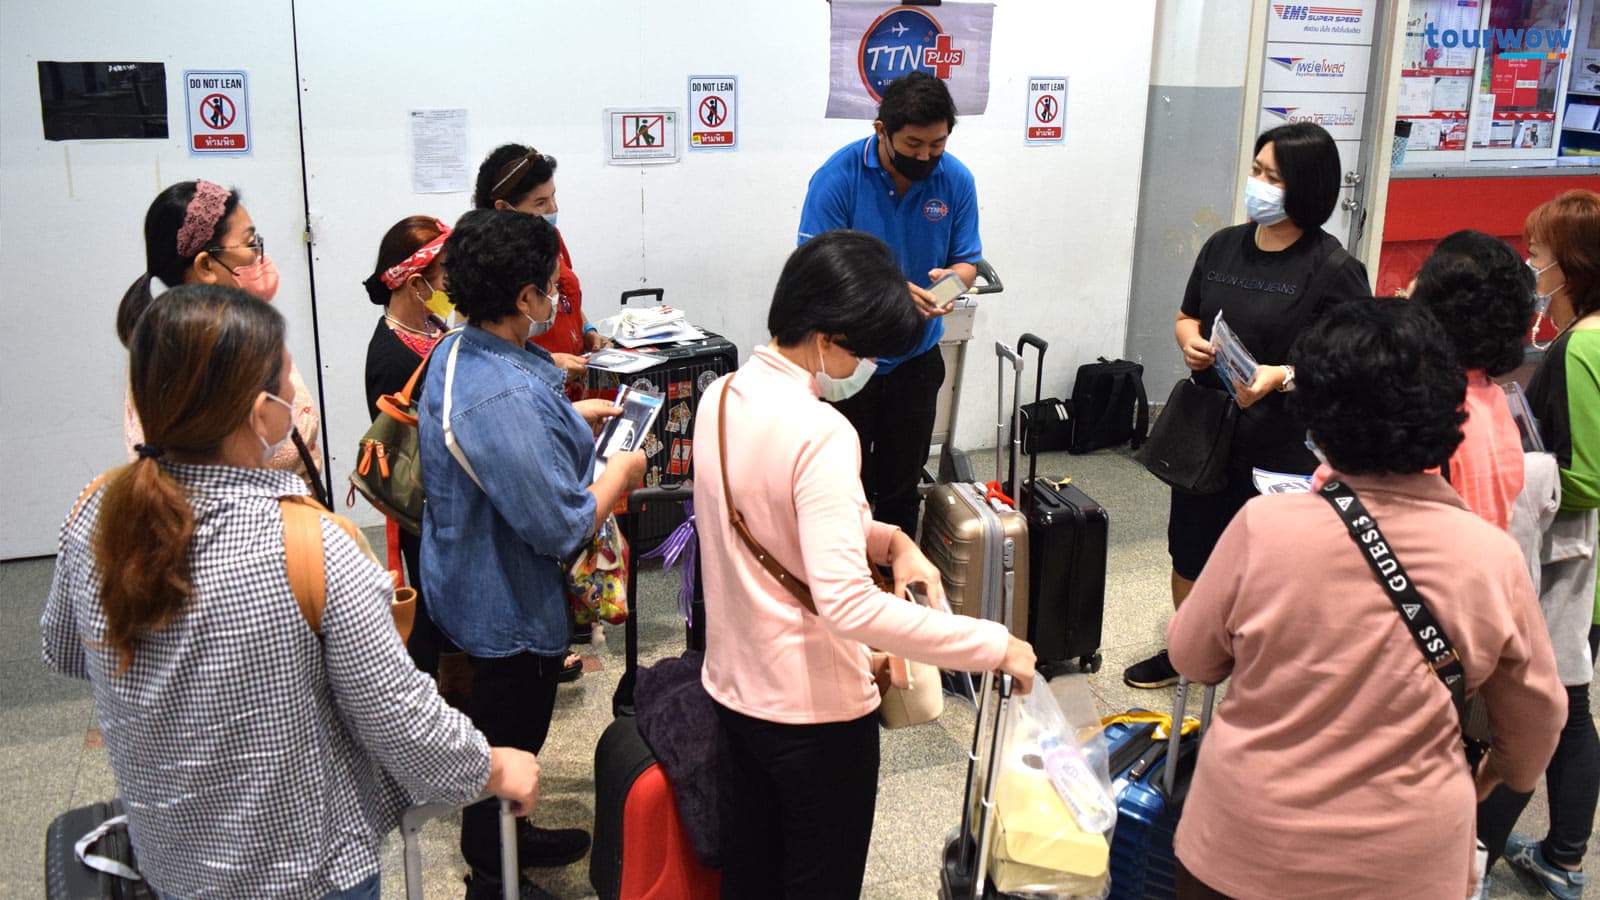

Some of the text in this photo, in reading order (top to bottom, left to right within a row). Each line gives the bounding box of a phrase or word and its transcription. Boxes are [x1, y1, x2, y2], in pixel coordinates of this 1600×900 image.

[1282, 5, 1309, 20] EMS
[867, 45, 961, 71] TTN PLUS
[190, 79, 242, 89] DO NOT LEAN
[692, 82, 733, 92] DO NOT LEAN
[1031, 83, 1064, 91] DO NOT LEAN
